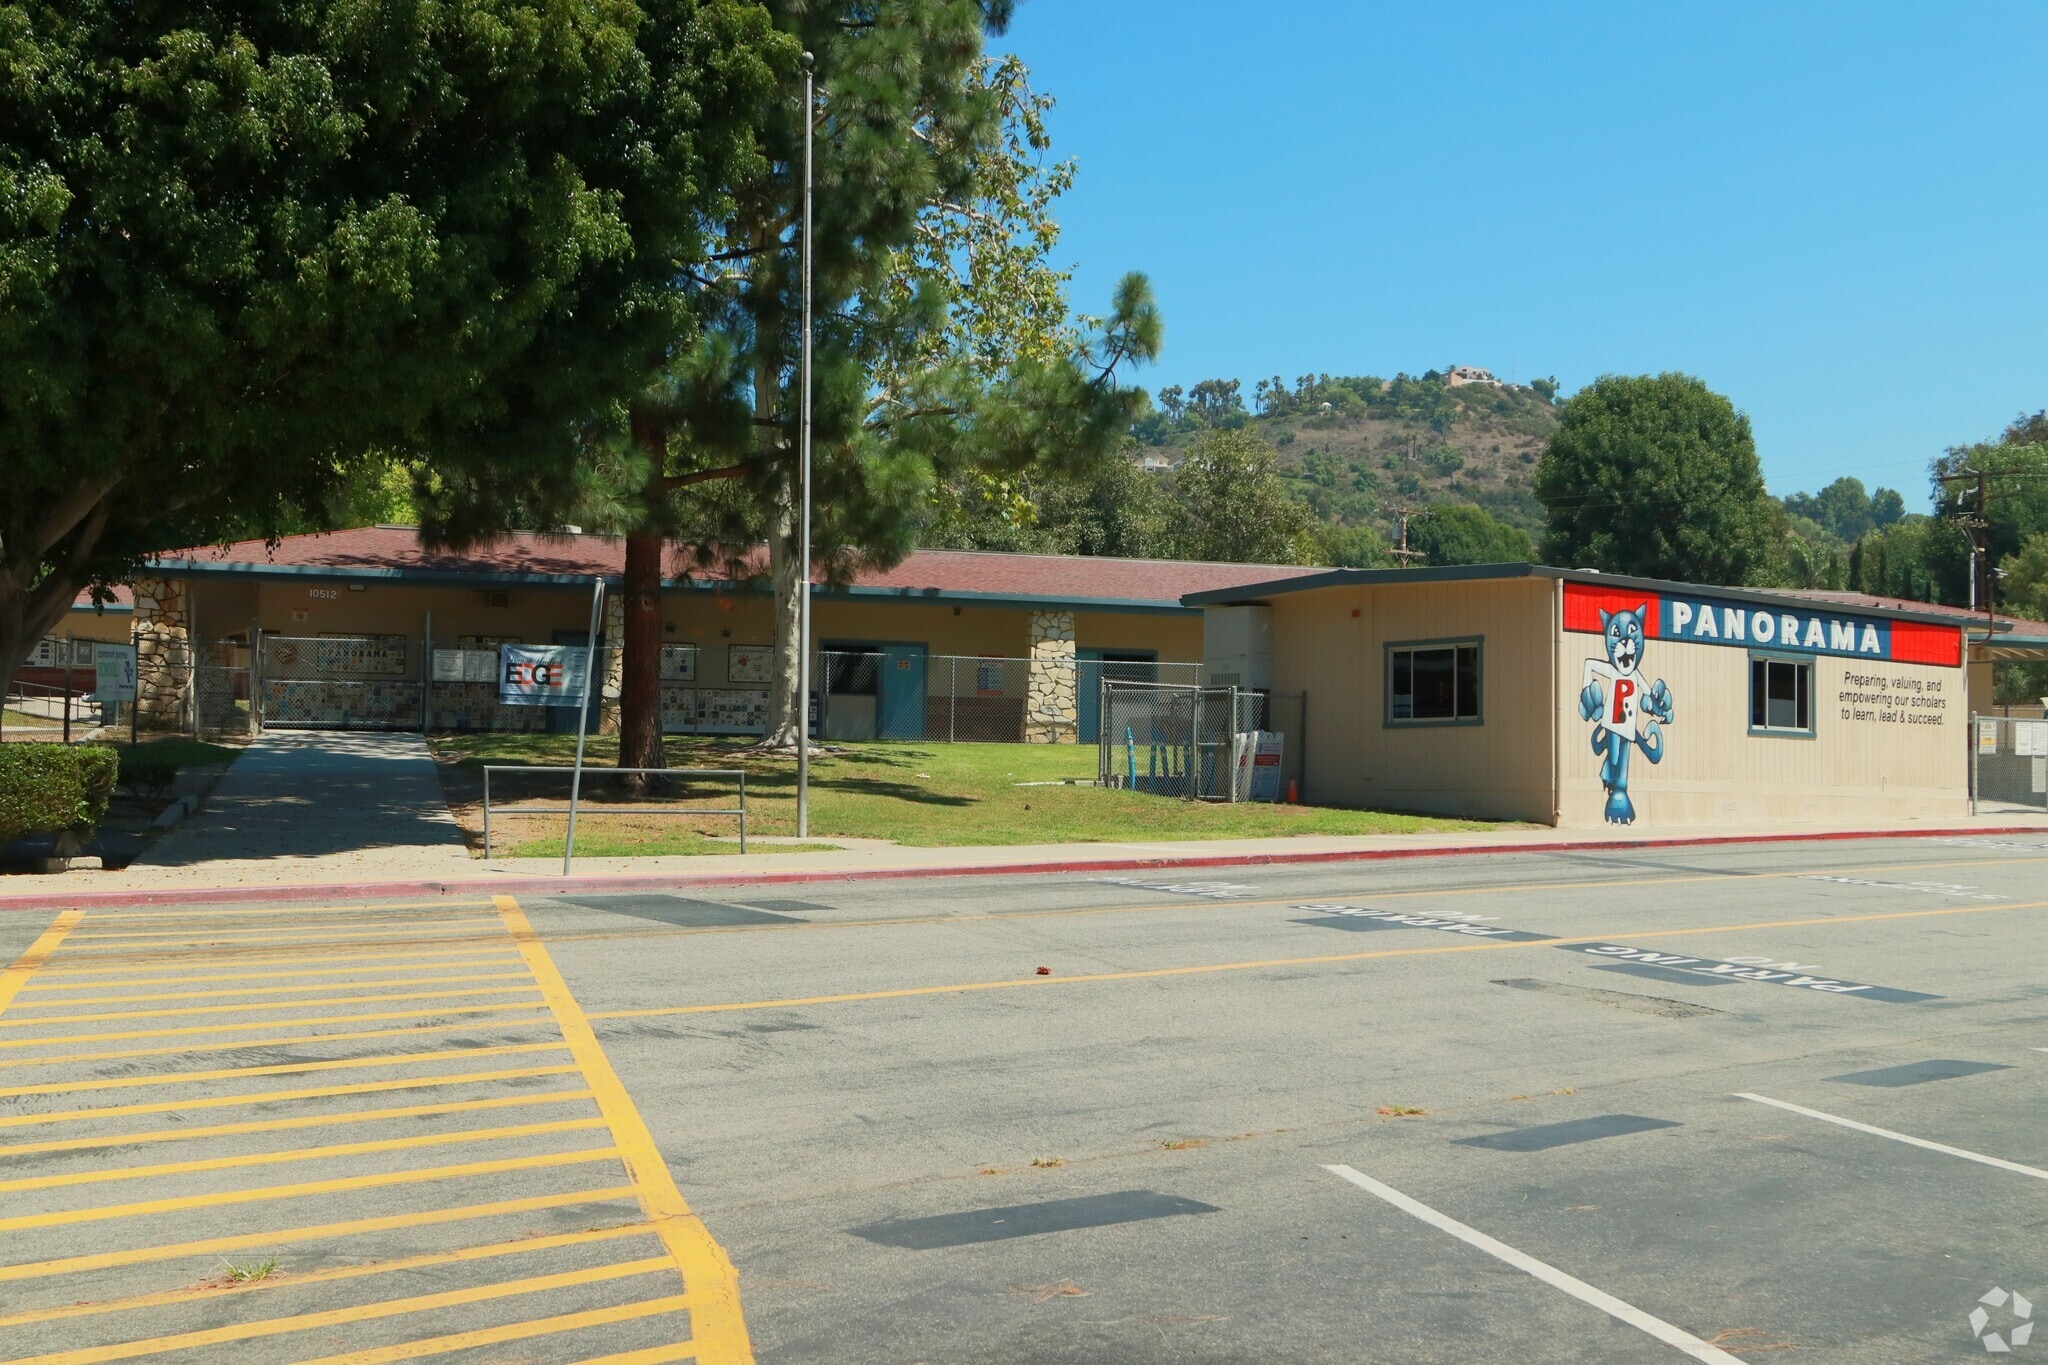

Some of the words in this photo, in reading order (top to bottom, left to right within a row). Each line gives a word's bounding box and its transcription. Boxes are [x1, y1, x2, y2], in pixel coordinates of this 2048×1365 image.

[309, 588, 337, 600] 10512
[1672, 601, 1881, 654] PANORAMA
[505, 662, 565, 687] EDGE
[1844, 671, 1889, 691] Preparing,
[1891, 676, 1924, 694] valuing,
[1926, 680, 1942, 692] and
[1612, 679, 1635, 724] P
[1839, 691, 1892, 708] empowering
[1894, 695, 1909, 706] our
[1911, 694, 1947, 709] scholars
[1841, 707, 1850, 720] to
[1852, 707, 1877, 723] learn,
[1878, 708, 1898, 722] lead
[1899, 710, 1905, 723] &
[1907, 713, 1944, 726] succeed.
[1298, 904, 1515, 936] PARKING
[1417, 910, 1500, 921] NO
[1584, 946, 1873, 992] PARKING
[1723, 956, 1824, 971] NO
